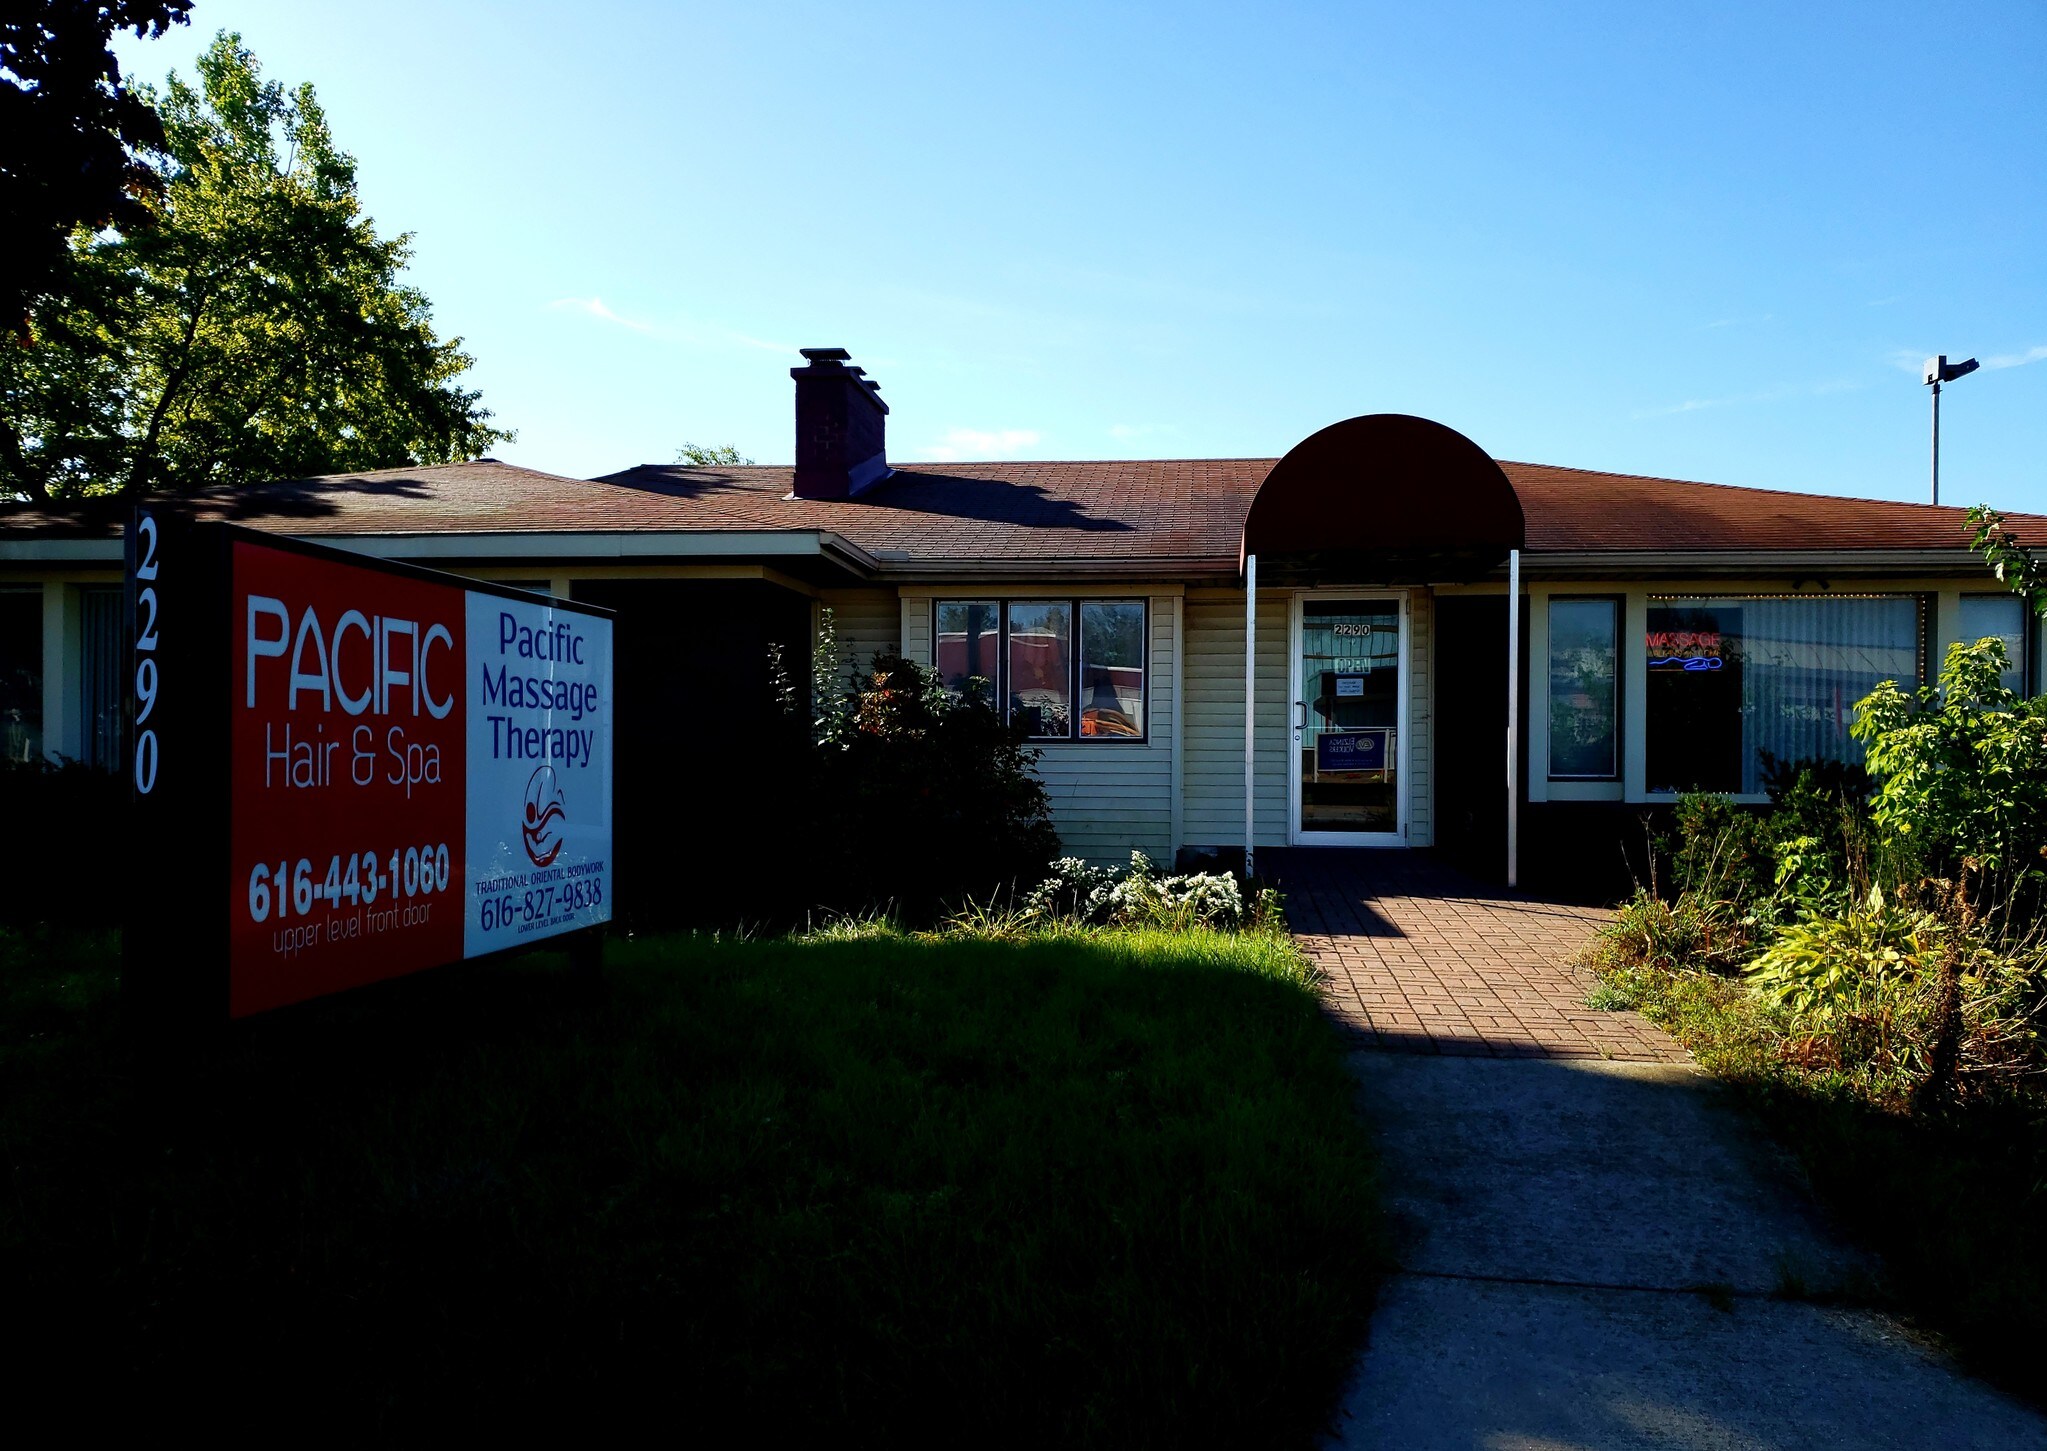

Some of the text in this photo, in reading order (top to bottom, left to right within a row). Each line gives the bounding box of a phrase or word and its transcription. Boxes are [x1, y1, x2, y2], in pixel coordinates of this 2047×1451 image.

[135, 516, 160, 795] 2290
[246, 594, 455, 720] PACIFIC
[499, 611, 585, 666] Pacific
[1335, 625, 1369, 635] 2290
[1646, 632, 1720, 647] MASSAGE
[481, 662, 598, 722] Massage
[1338, 658, 1370, 673] OPEN
[266, 722, 442, 799] Hair & Spa
[486, 715, 595, 769] Therapy
[248, 842, 450, 923] 616-443-1060
[475, 861, 604, 895] TRADITIONAL ORIENTAL BODYWORK
[481, 877, 602, 931] 616-827-9838
[272, 900, 433, 958] upper level front door
[518, 913, 575, 933] LOWER LEVEL BACK DOOR
